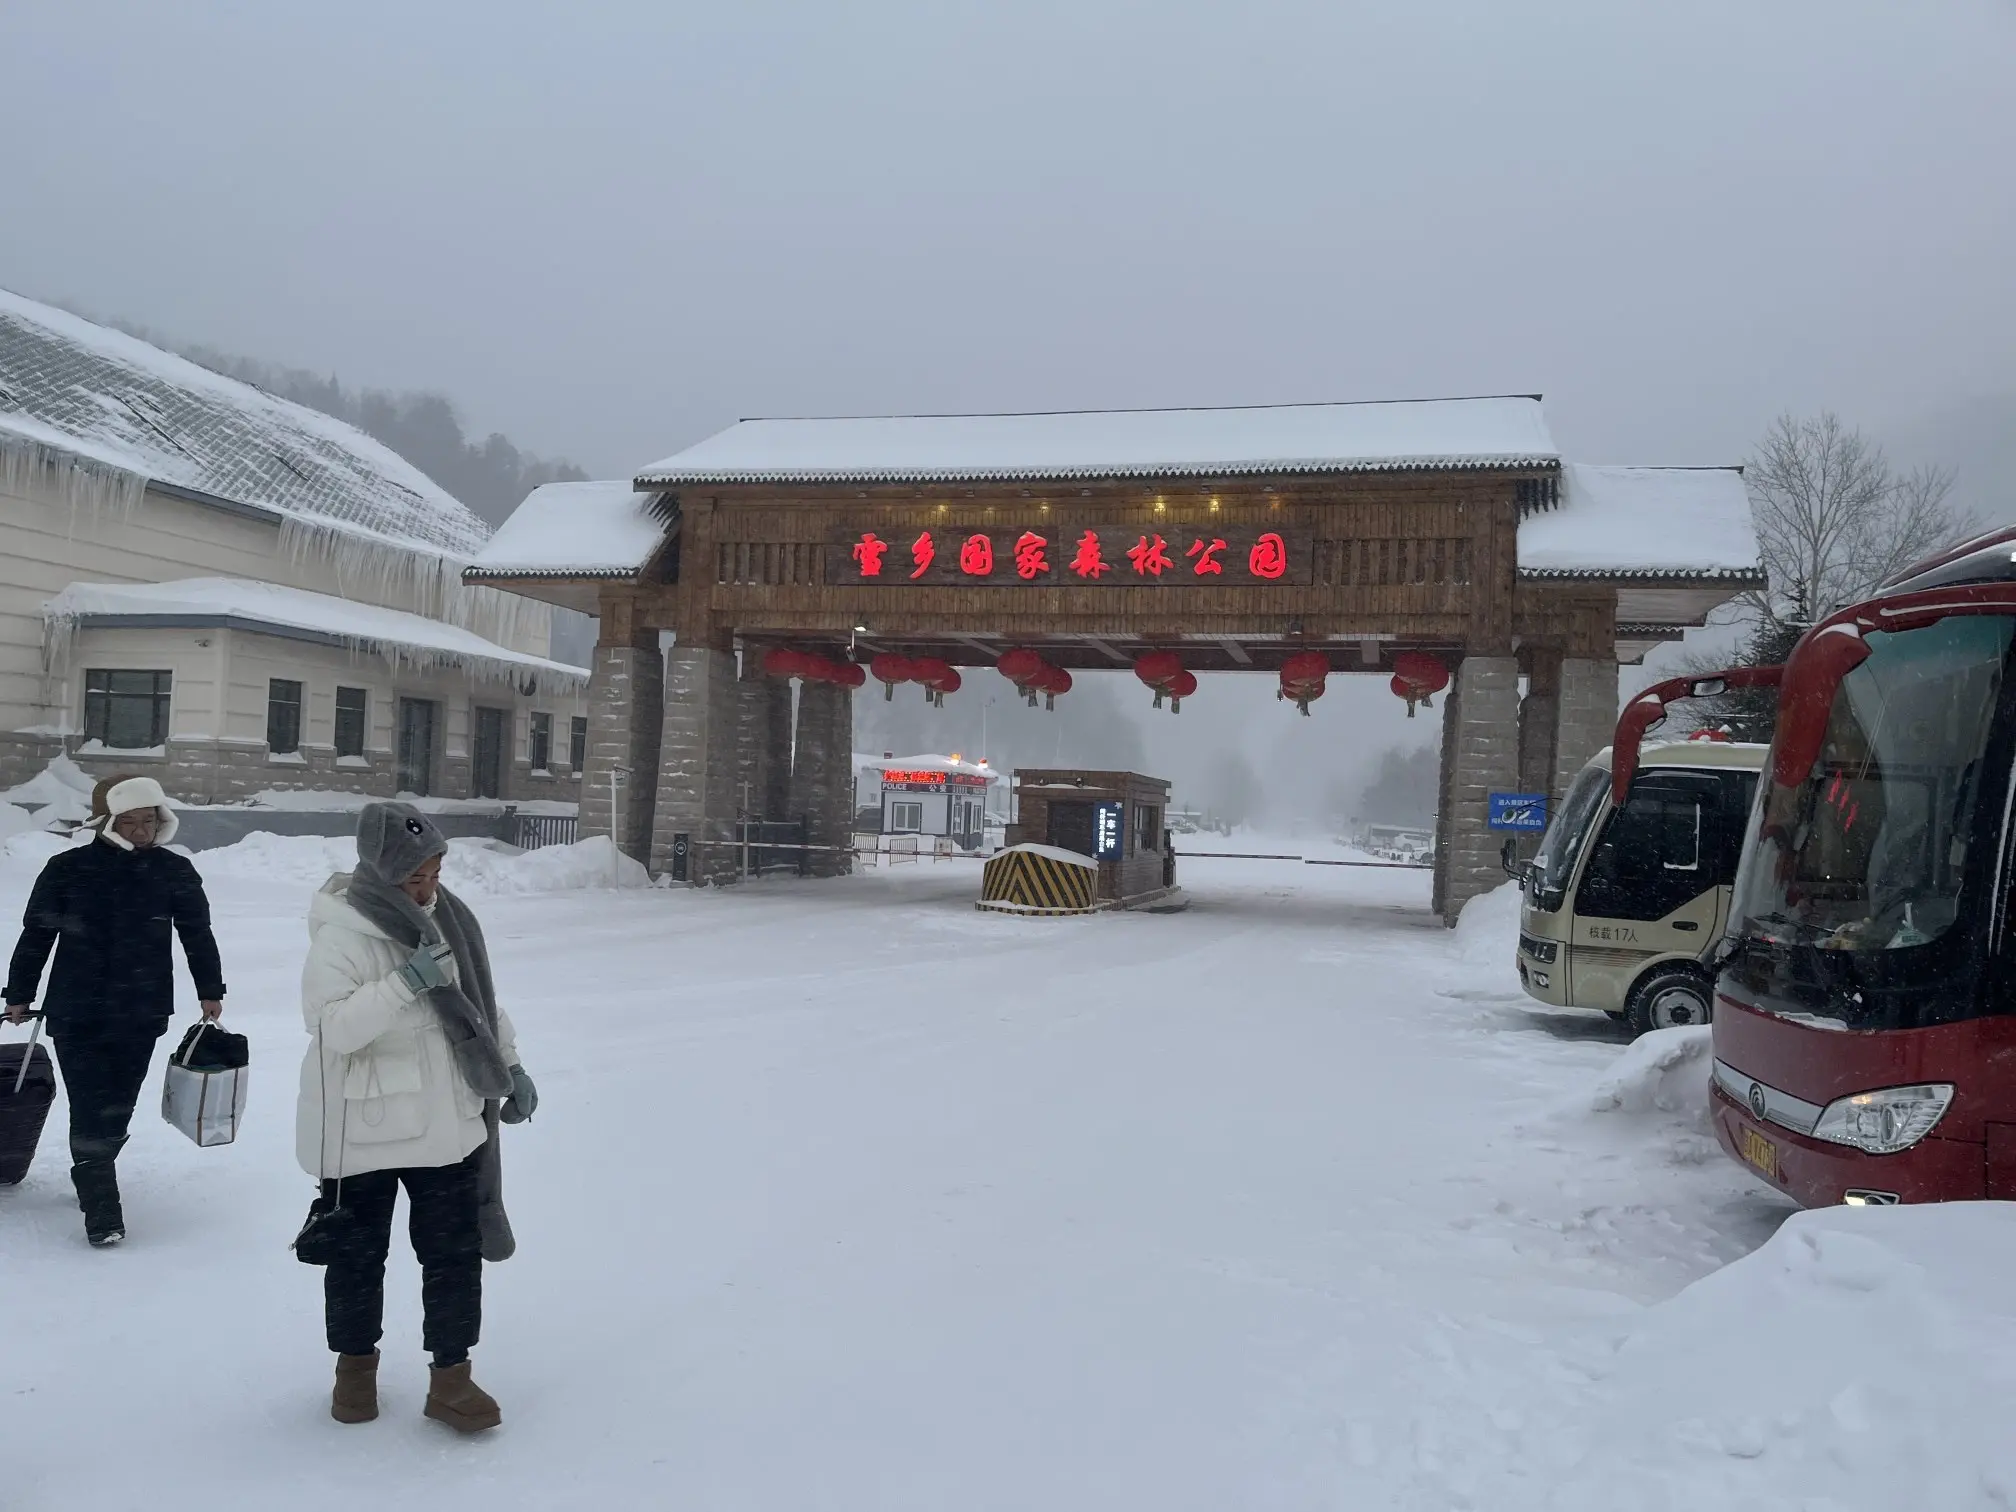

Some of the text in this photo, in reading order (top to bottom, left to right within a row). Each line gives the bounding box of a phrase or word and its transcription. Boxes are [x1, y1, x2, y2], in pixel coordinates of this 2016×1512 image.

[852, 529, 1287, 581] 雪乡国家森林公园
[882, 782, 908, 791] POLICE
[928, 784, 947, 793] 公安
[1106, 812, 1117, 849] 一车一杆
[1589, 925, 1639, 943] 核载17人
